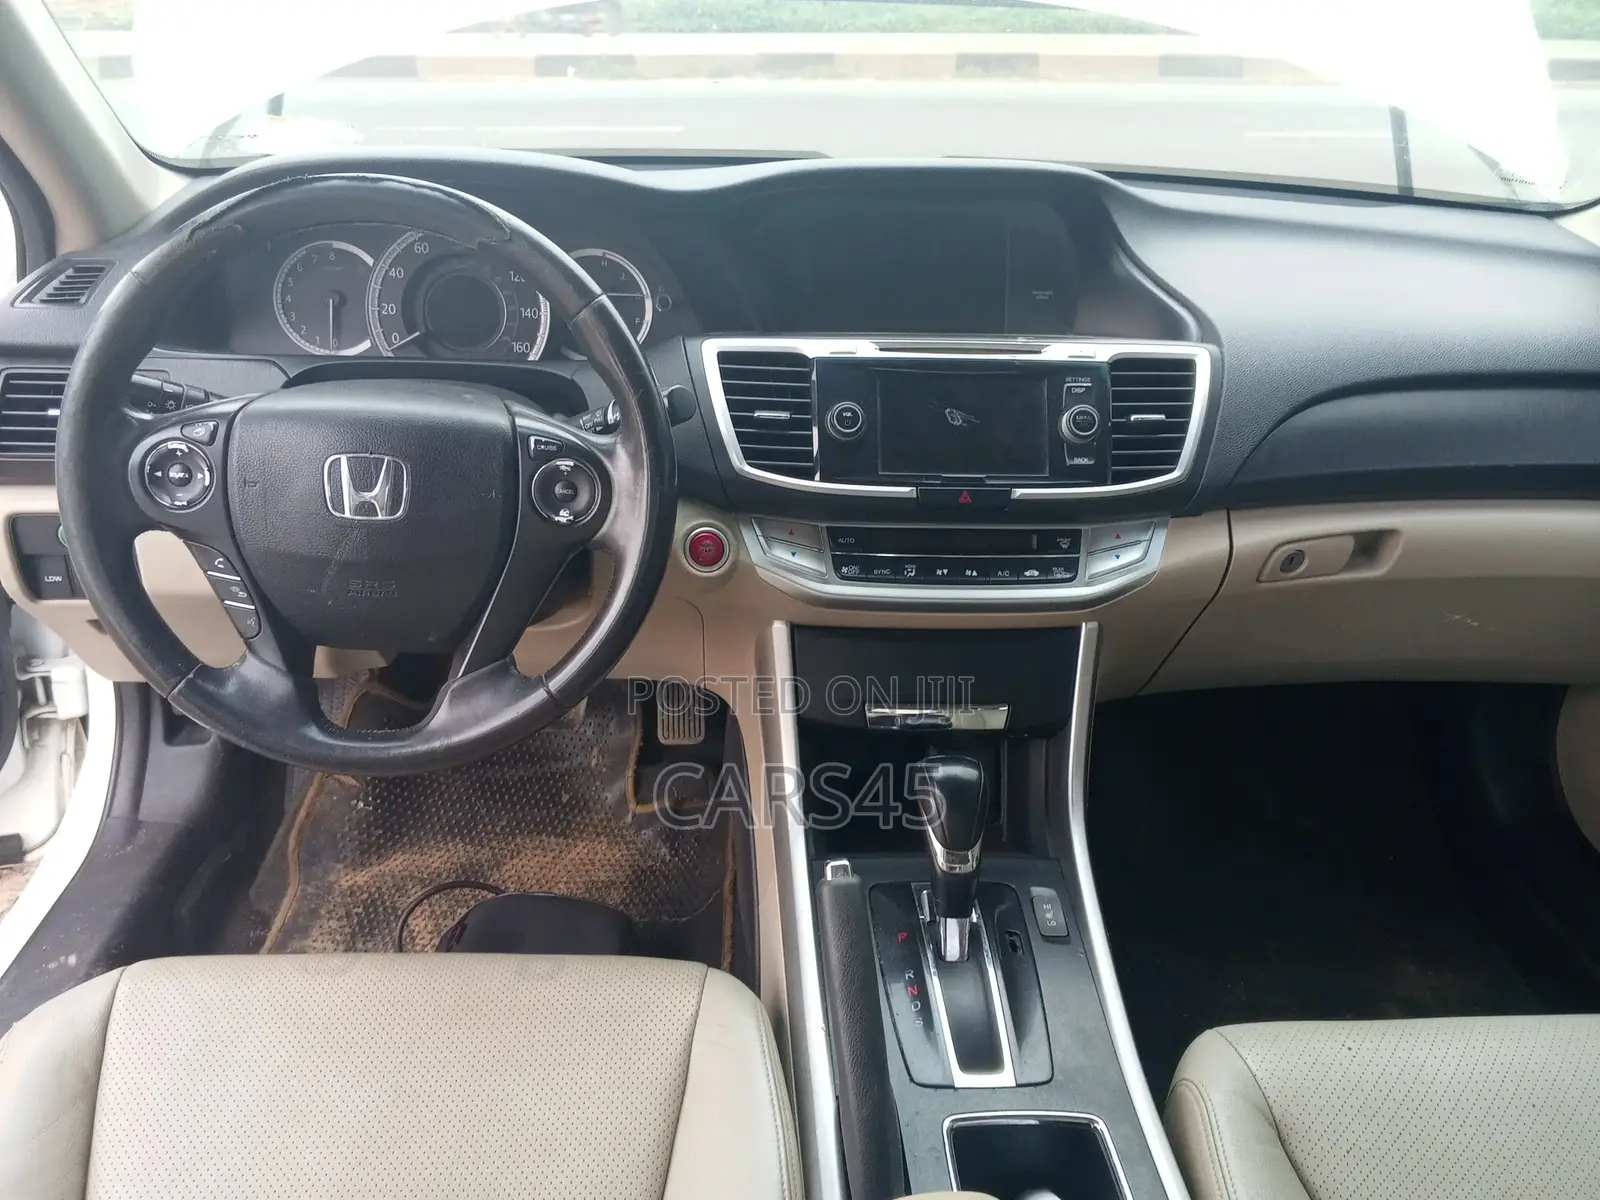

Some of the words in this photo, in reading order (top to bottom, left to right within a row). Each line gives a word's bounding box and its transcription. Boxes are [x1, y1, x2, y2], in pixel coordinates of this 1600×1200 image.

[414, 243, 429, 254] 60
[312, 255, 318, 263] 7
[329, 252, 335, 261] 8
[389, 268, 404, 279] 40
[509, 271, 525, 282] 12
[288, 278, 294, 287] 5
[285, 294, 292, 302] 4
[381, 304, 396, 315] 20
[520, 308, 538, 319] 140
[290, 312, 296, 321] 3
[301, 325, 306, 335] 2
[315, 336, 320, 345] 1
[391, 333, 399, 343] 0
[512, 342, 530, 353] 160
[897, 932, 907, 942] P
[905, 969, 914, 980] R
[907, 984, 918, 996] N
[911, 1001, 921, 1012] D
